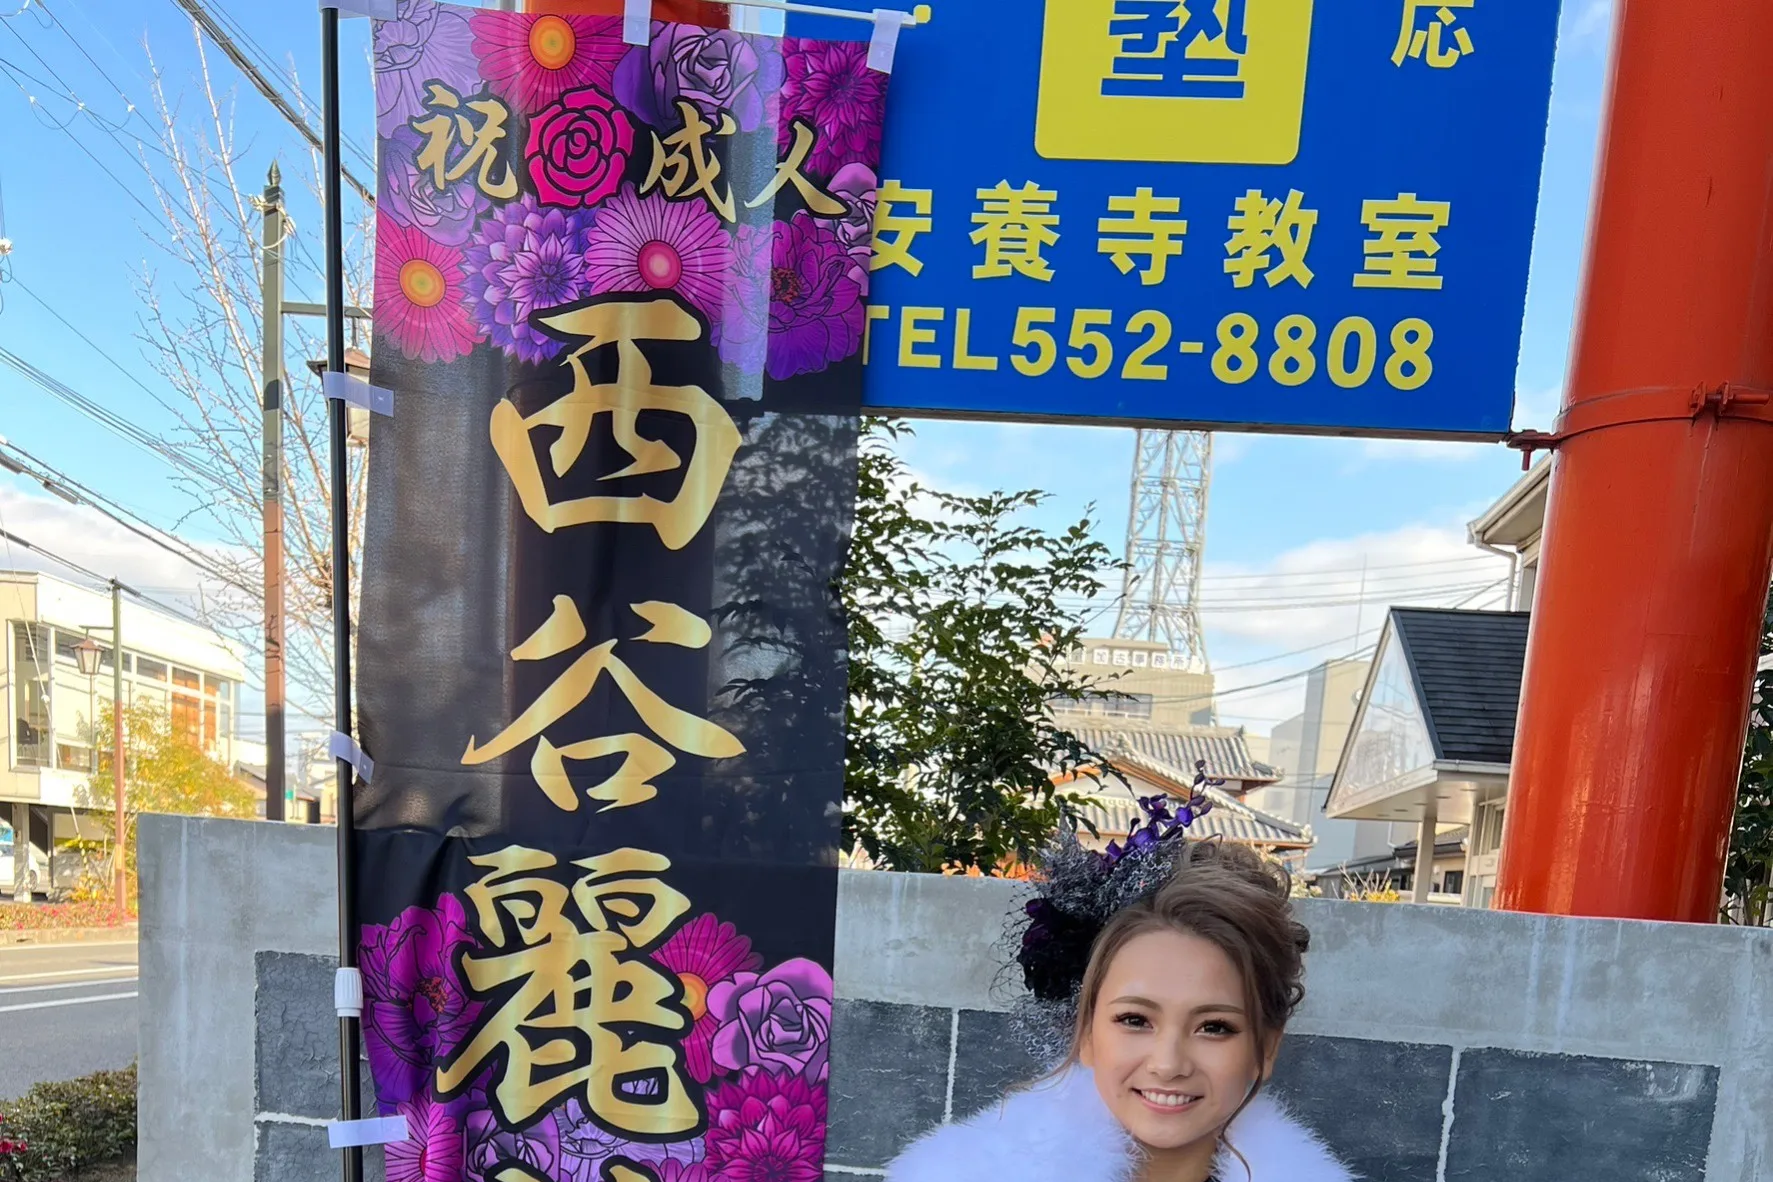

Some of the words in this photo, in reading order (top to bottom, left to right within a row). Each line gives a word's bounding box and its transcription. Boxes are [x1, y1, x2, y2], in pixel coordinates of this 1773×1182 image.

[1101, 0, 1247, 99] 塾
[1391, 0, 1475, 68] 応
[413, 84, 520, 200] 祝
[638, 101, 850, 223] 成人
[868, 179, 1451, 290] 安養寺教室
